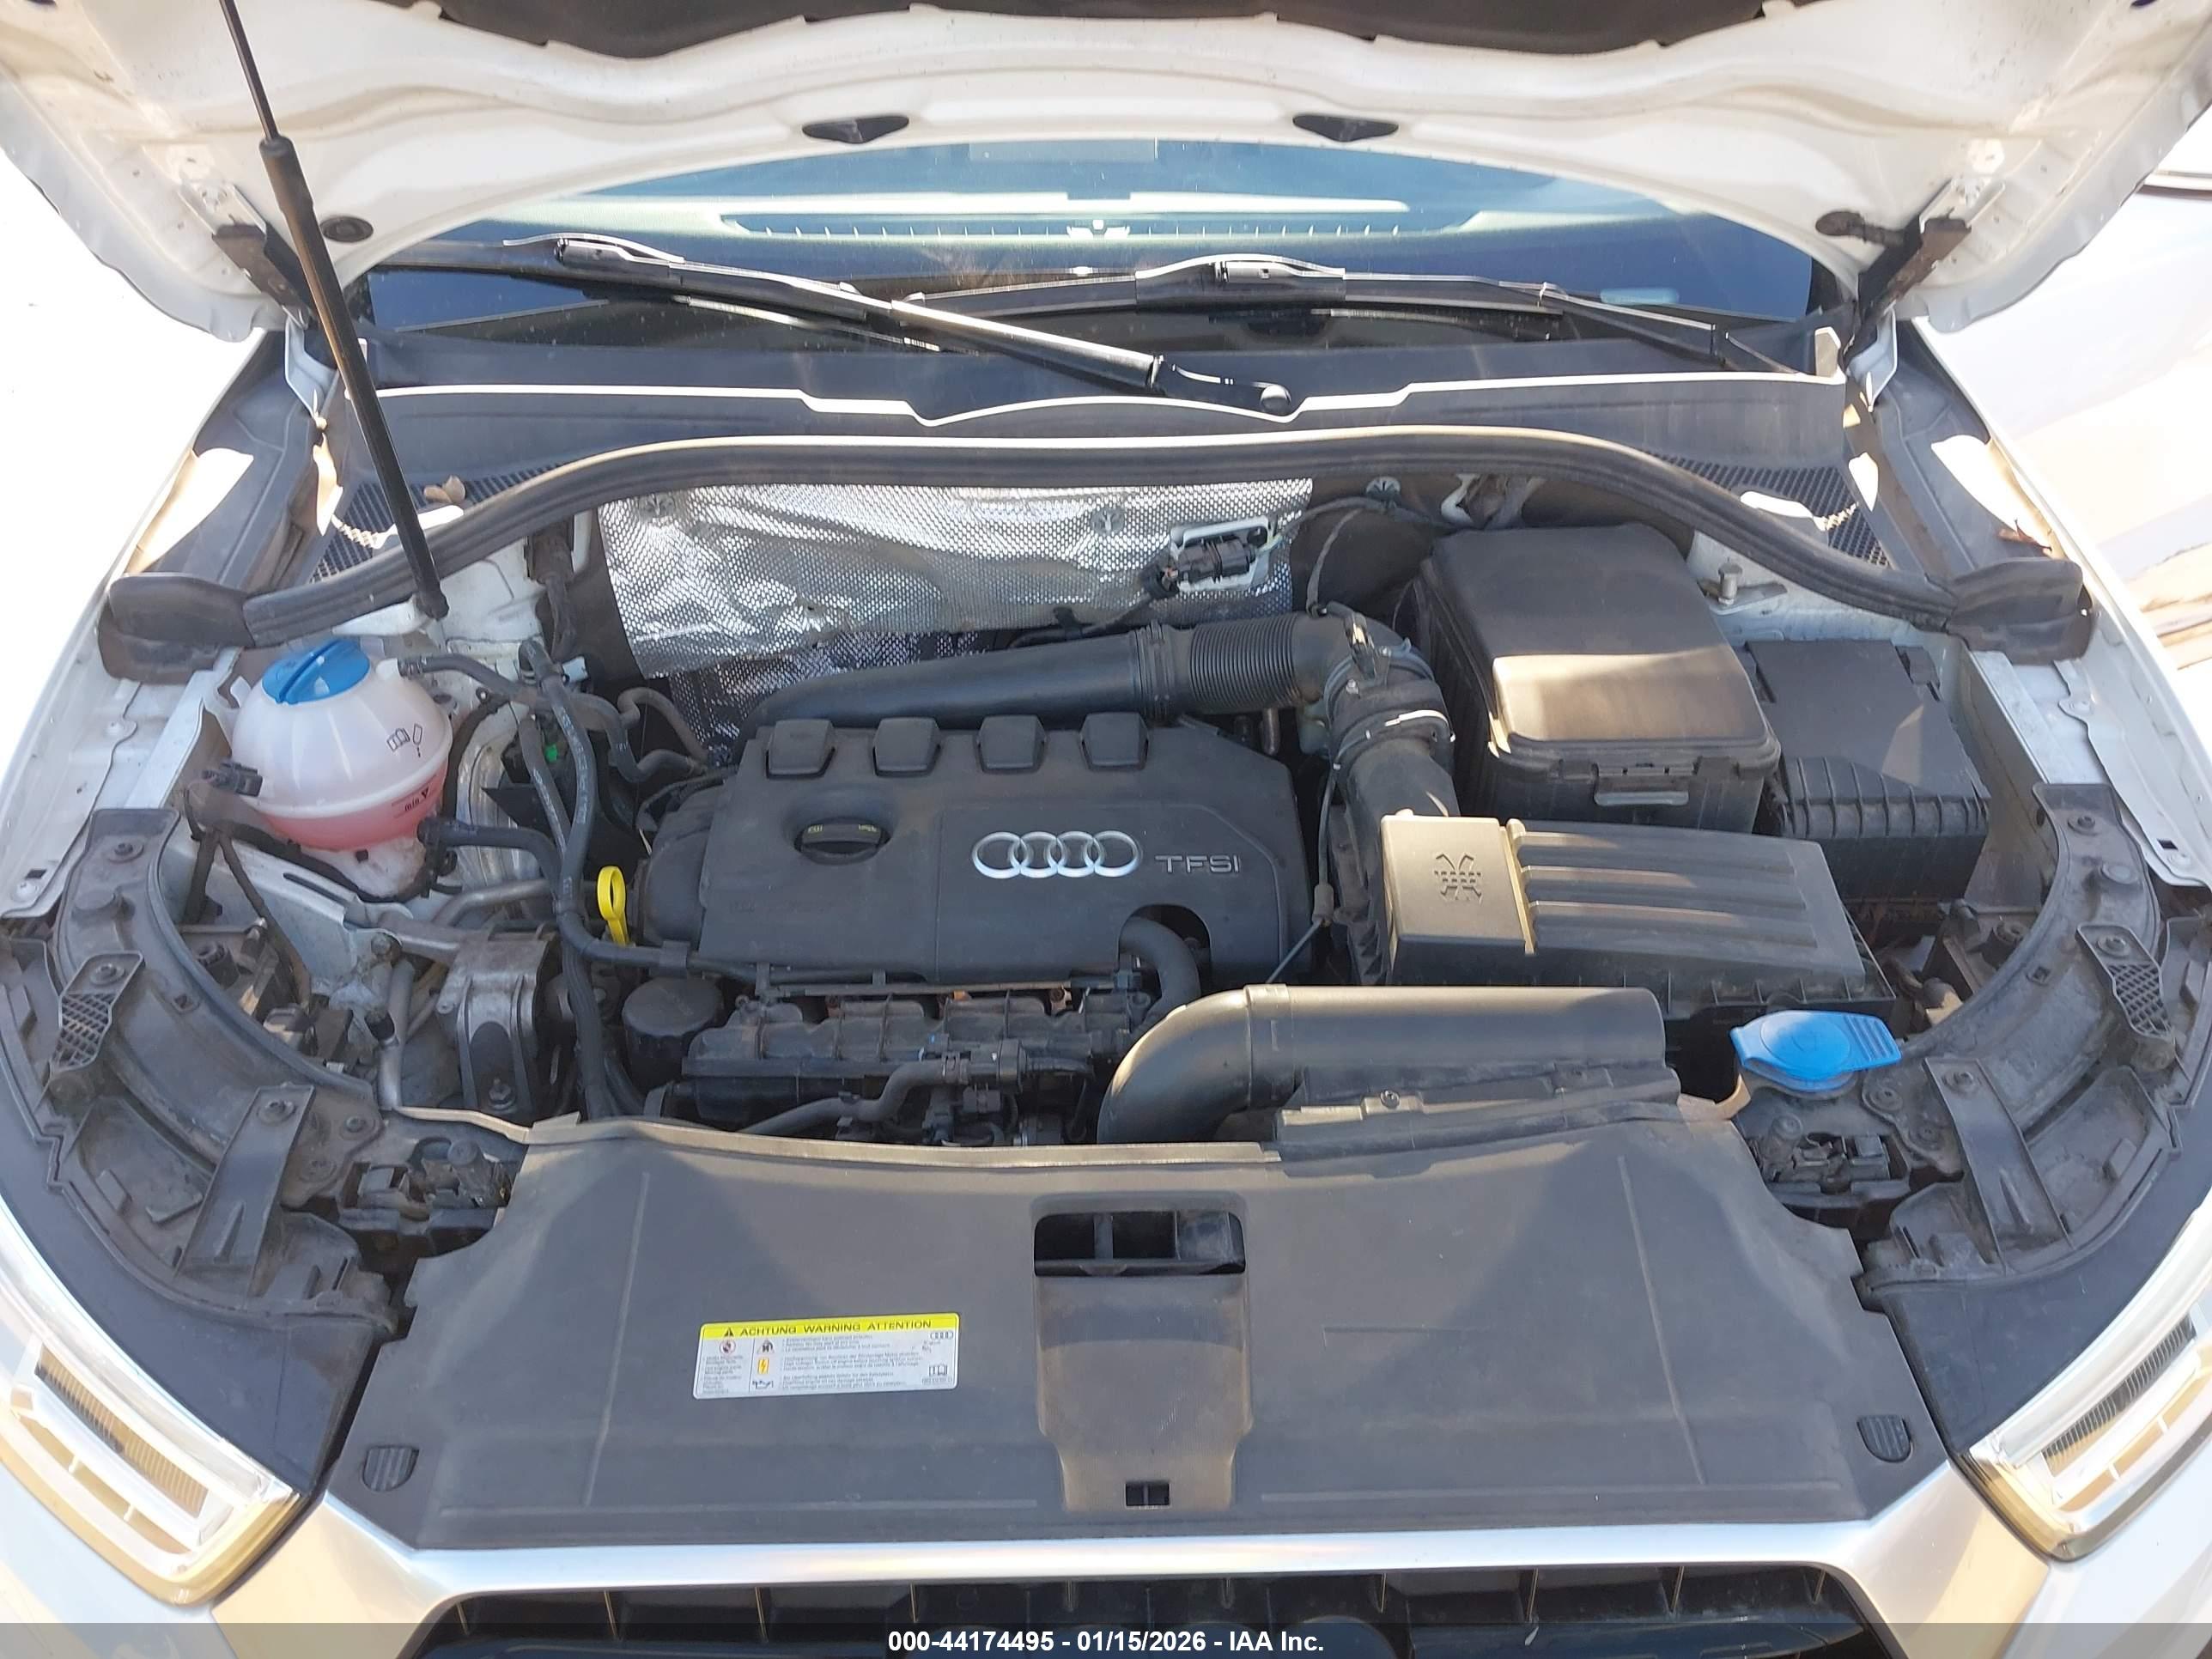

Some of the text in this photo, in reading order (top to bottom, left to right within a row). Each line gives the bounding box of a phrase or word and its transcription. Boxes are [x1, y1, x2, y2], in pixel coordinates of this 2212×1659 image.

[404, 798, 420, 812] min
[1155, 854, 1242, 874] TFSI
[739, 1319, 933, 1337] ACHTUNG WARNING ATTENTION
